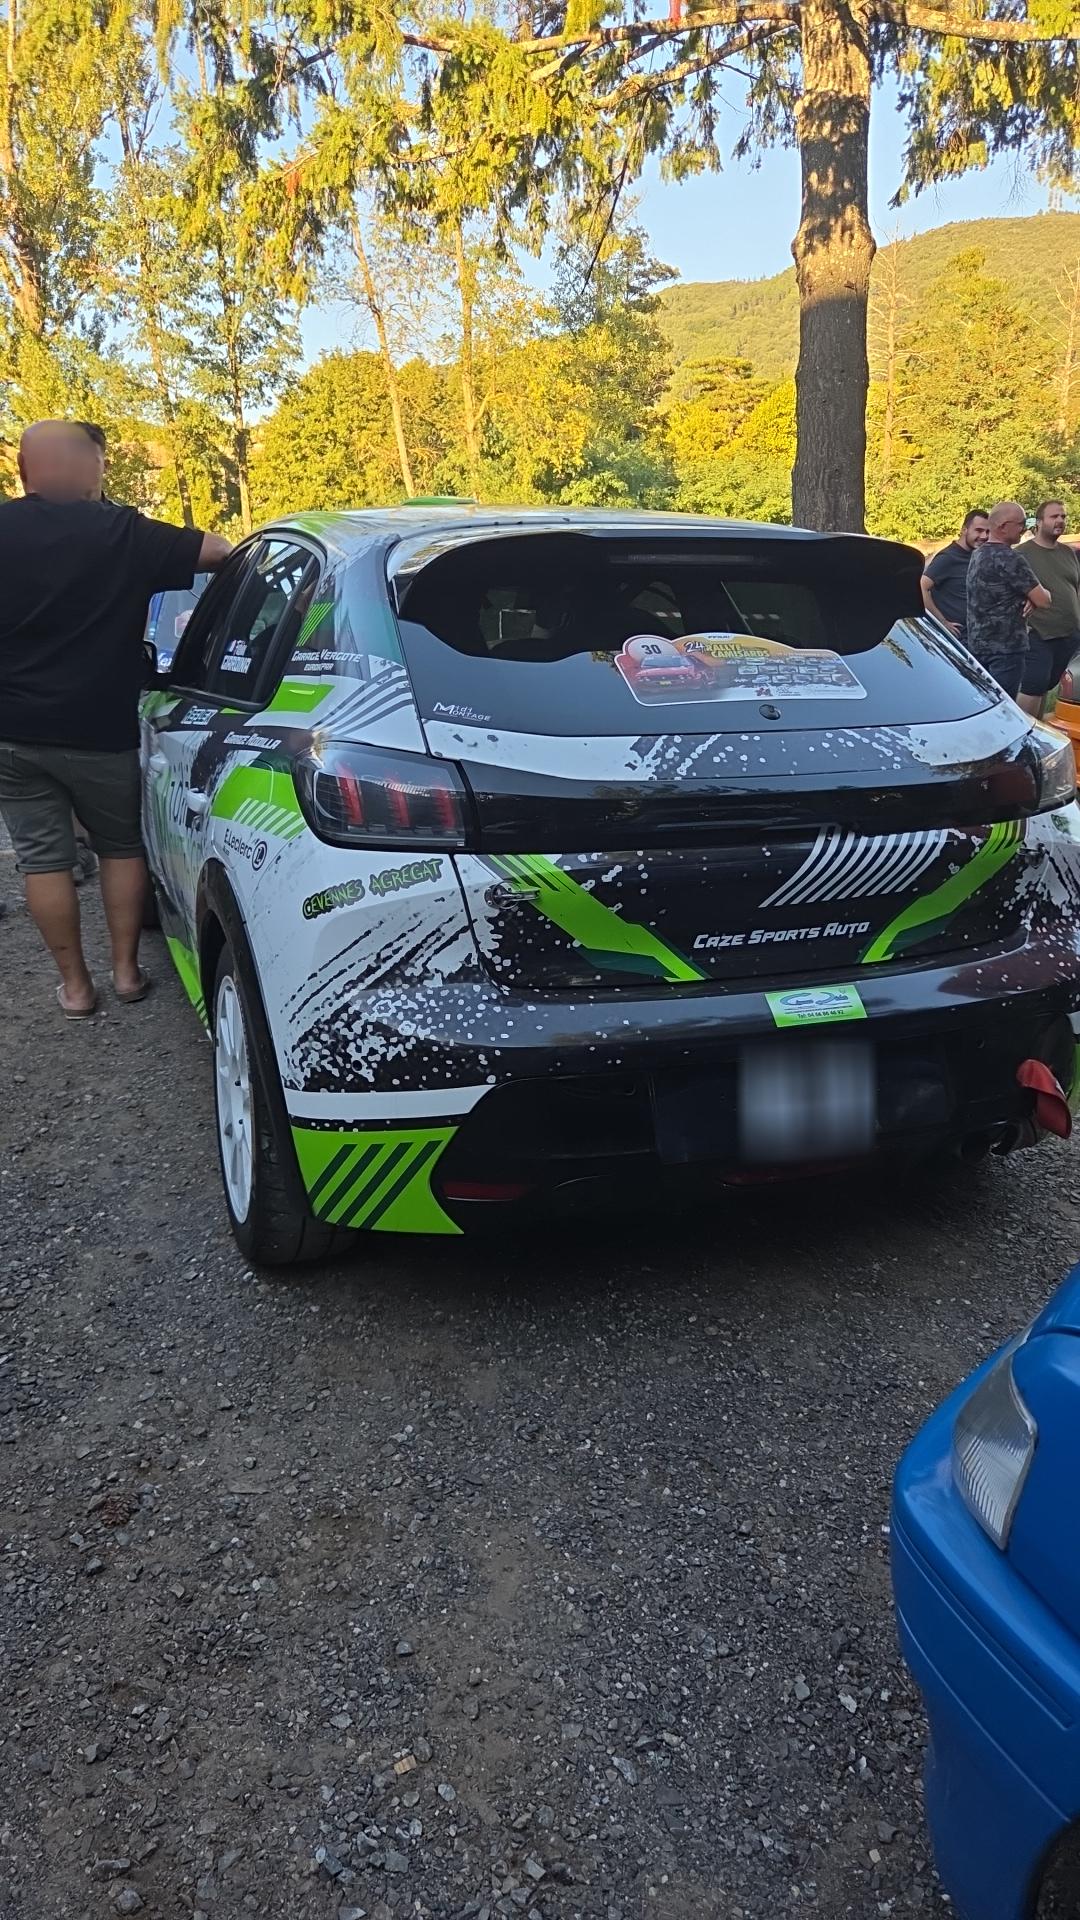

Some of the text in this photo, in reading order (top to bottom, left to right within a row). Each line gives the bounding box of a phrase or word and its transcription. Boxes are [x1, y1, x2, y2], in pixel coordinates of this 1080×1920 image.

[641, 644, 662, 655] 30
[684, 641, 706, 653] 24
[291, 648, 364, 663] GARAGE VERGOTE
[711, 649, 770, 659] CAMISARDS
[303, 859, 443, 919] CEVENNES AGREGAT
[693, 921, 870, 949] CAZE SPORTS AUTO
